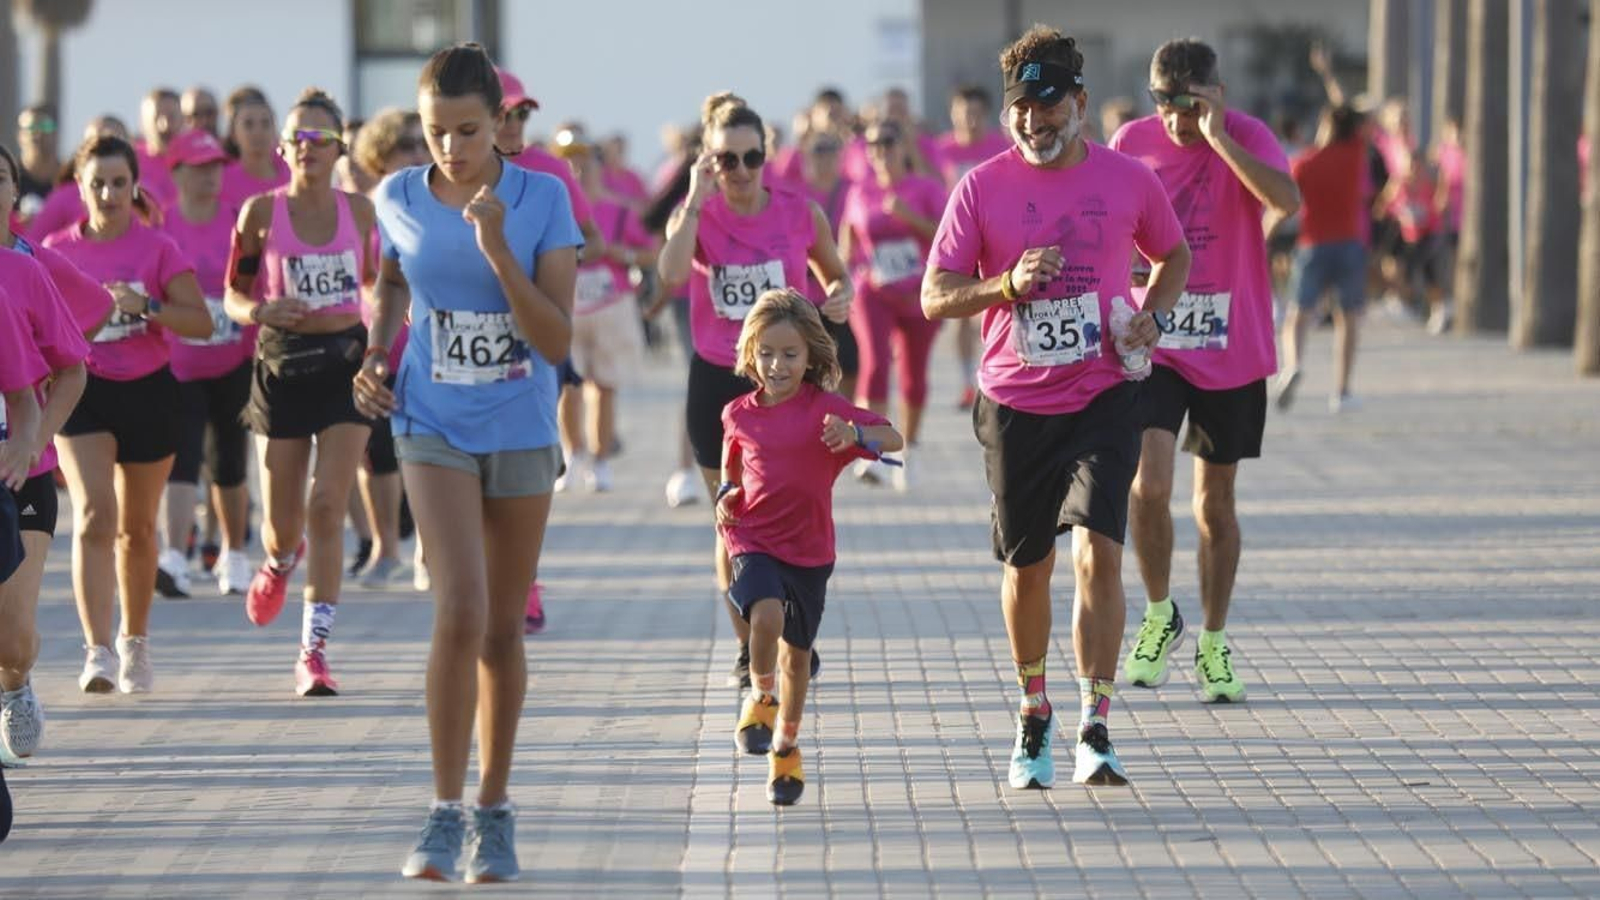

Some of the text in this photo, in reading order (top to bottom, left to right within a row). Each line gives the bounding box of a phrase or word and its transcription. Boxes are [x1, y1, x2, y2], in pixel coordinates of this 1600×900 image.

[298, 267, 346, 297] 465
[447, 331, 515, 367] 462
[1036, 318, 1079, 351] 35
